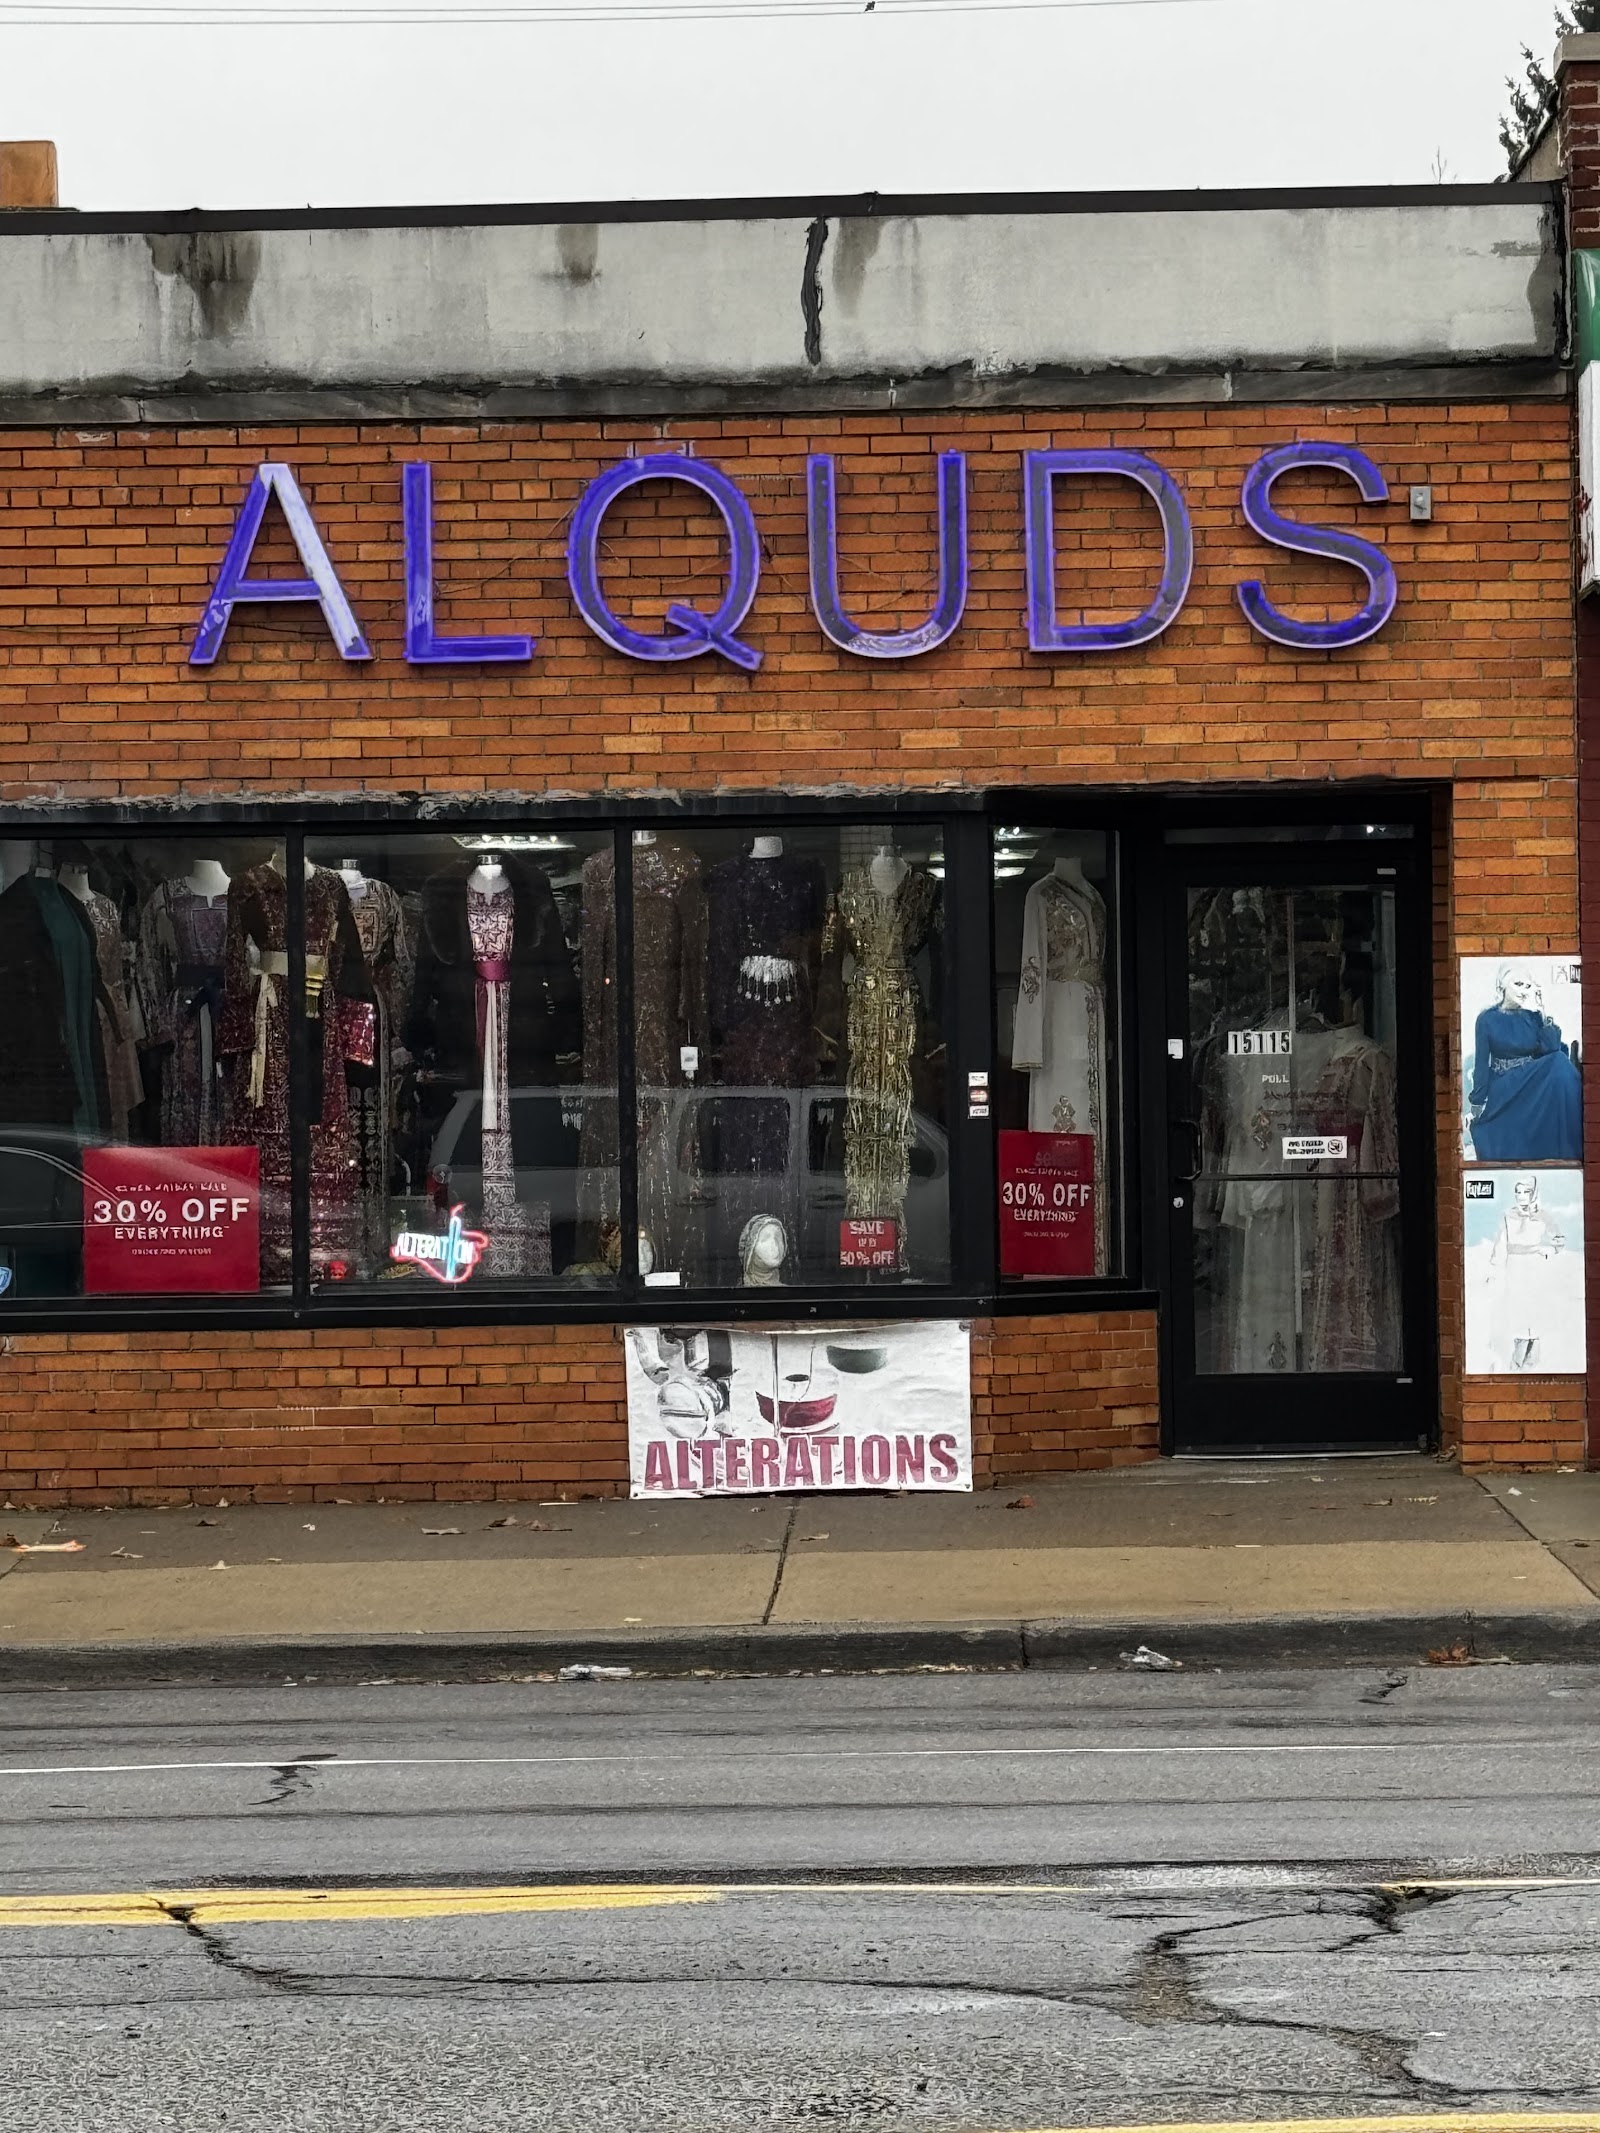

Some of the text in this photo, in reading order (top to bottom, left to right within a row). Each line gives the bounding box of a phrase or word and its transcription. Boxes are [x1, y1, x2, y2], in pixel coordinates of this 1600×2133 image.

[189, 440, 1399, 672] ALQUDS
[1232, 1031, 1290, 1054] 15115
[1002, 1181, 1093, 1207] 30% OFF
[93, 1198, 250, 1223] 30% OFF
[849, 1220, 885, 1235] SAVE
[872, 1250, 895, 1265] OFF
[643, 1433, 960, 1491] ALTERATIONS
